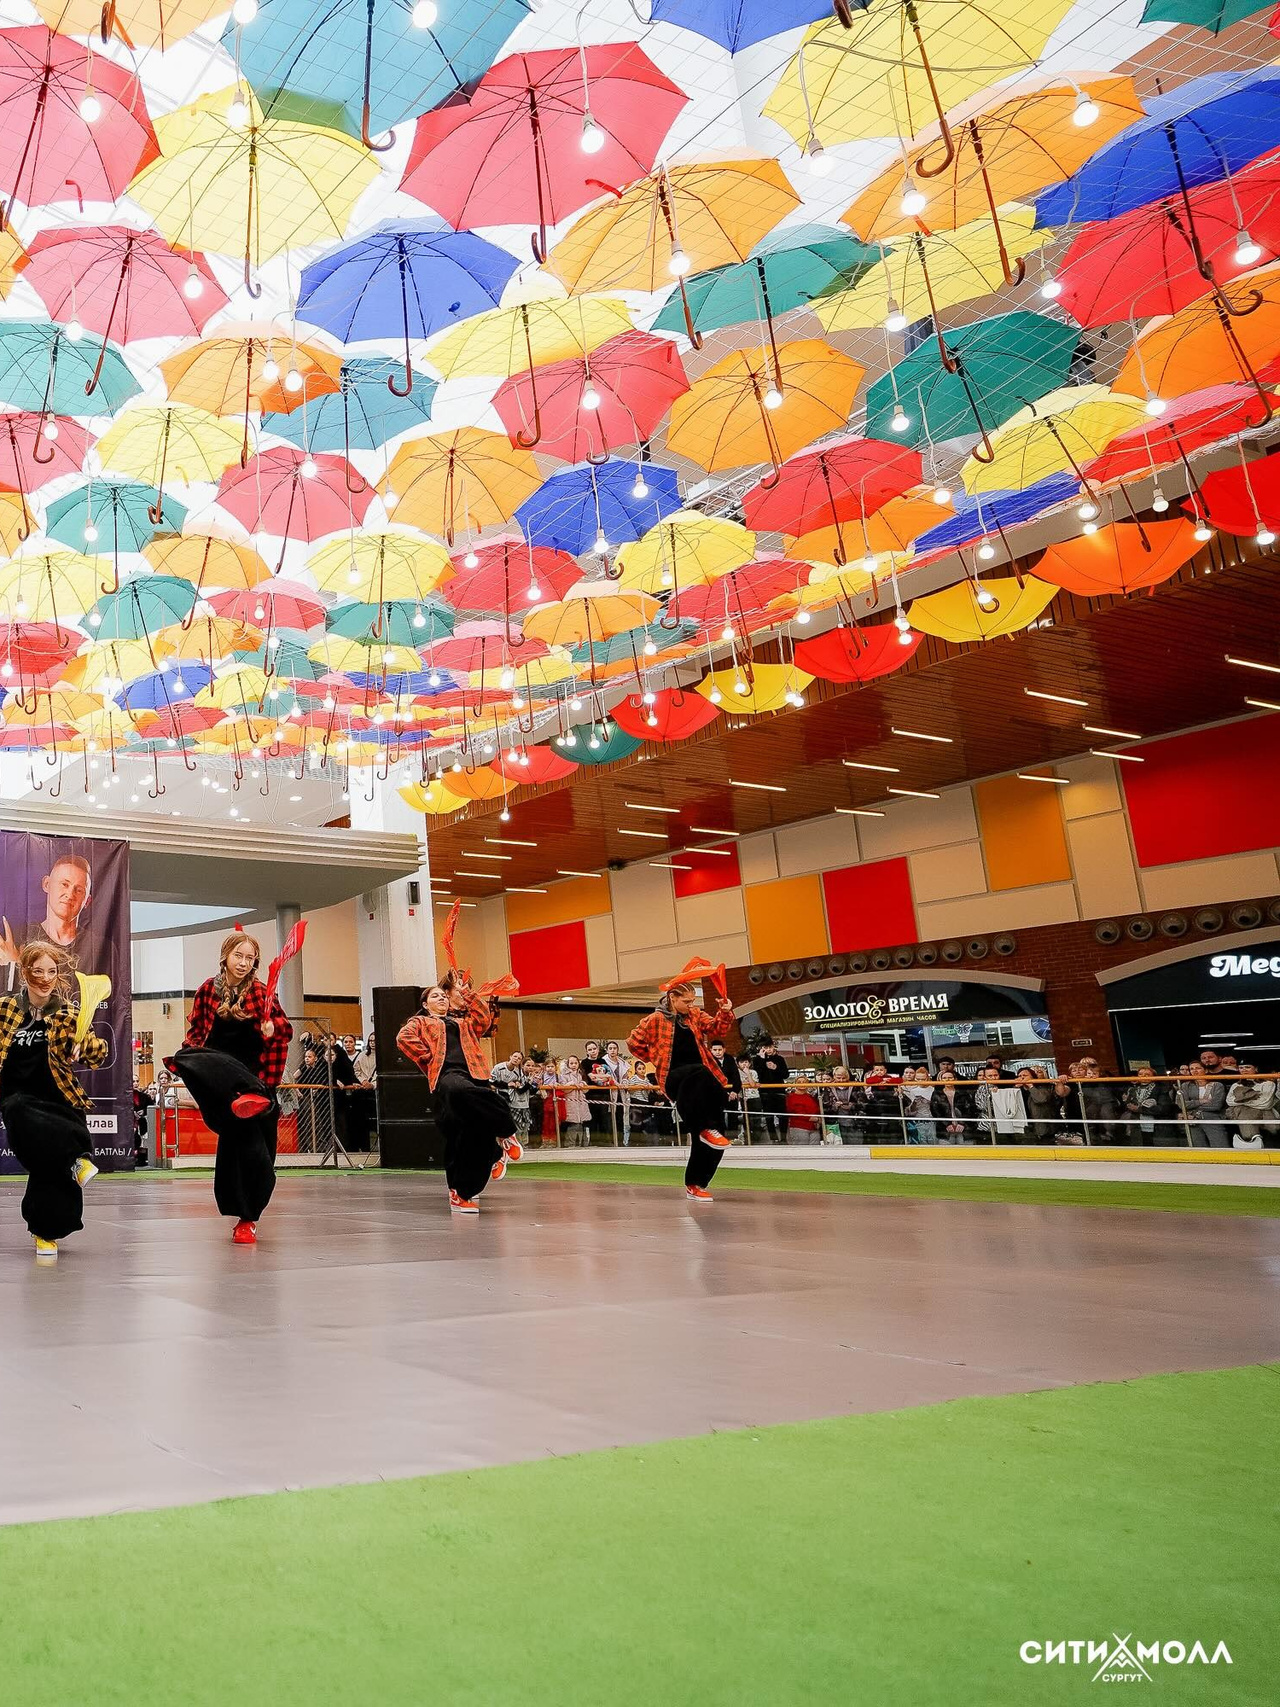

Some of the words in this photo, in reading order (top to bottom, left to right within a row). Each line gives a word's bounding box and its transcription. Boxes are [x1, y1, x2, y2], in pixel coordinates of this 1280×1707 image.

[888, 993, 949, 1013] ВРЕМЯ
[820, 1018, 884, 1029] СПЕЦИАЛИЗИРОВАННЫЙ
[887, 1016, 914, 1025] МАГАЗИН
[94, 1147, 126, 1156] БАТТЛЫ
